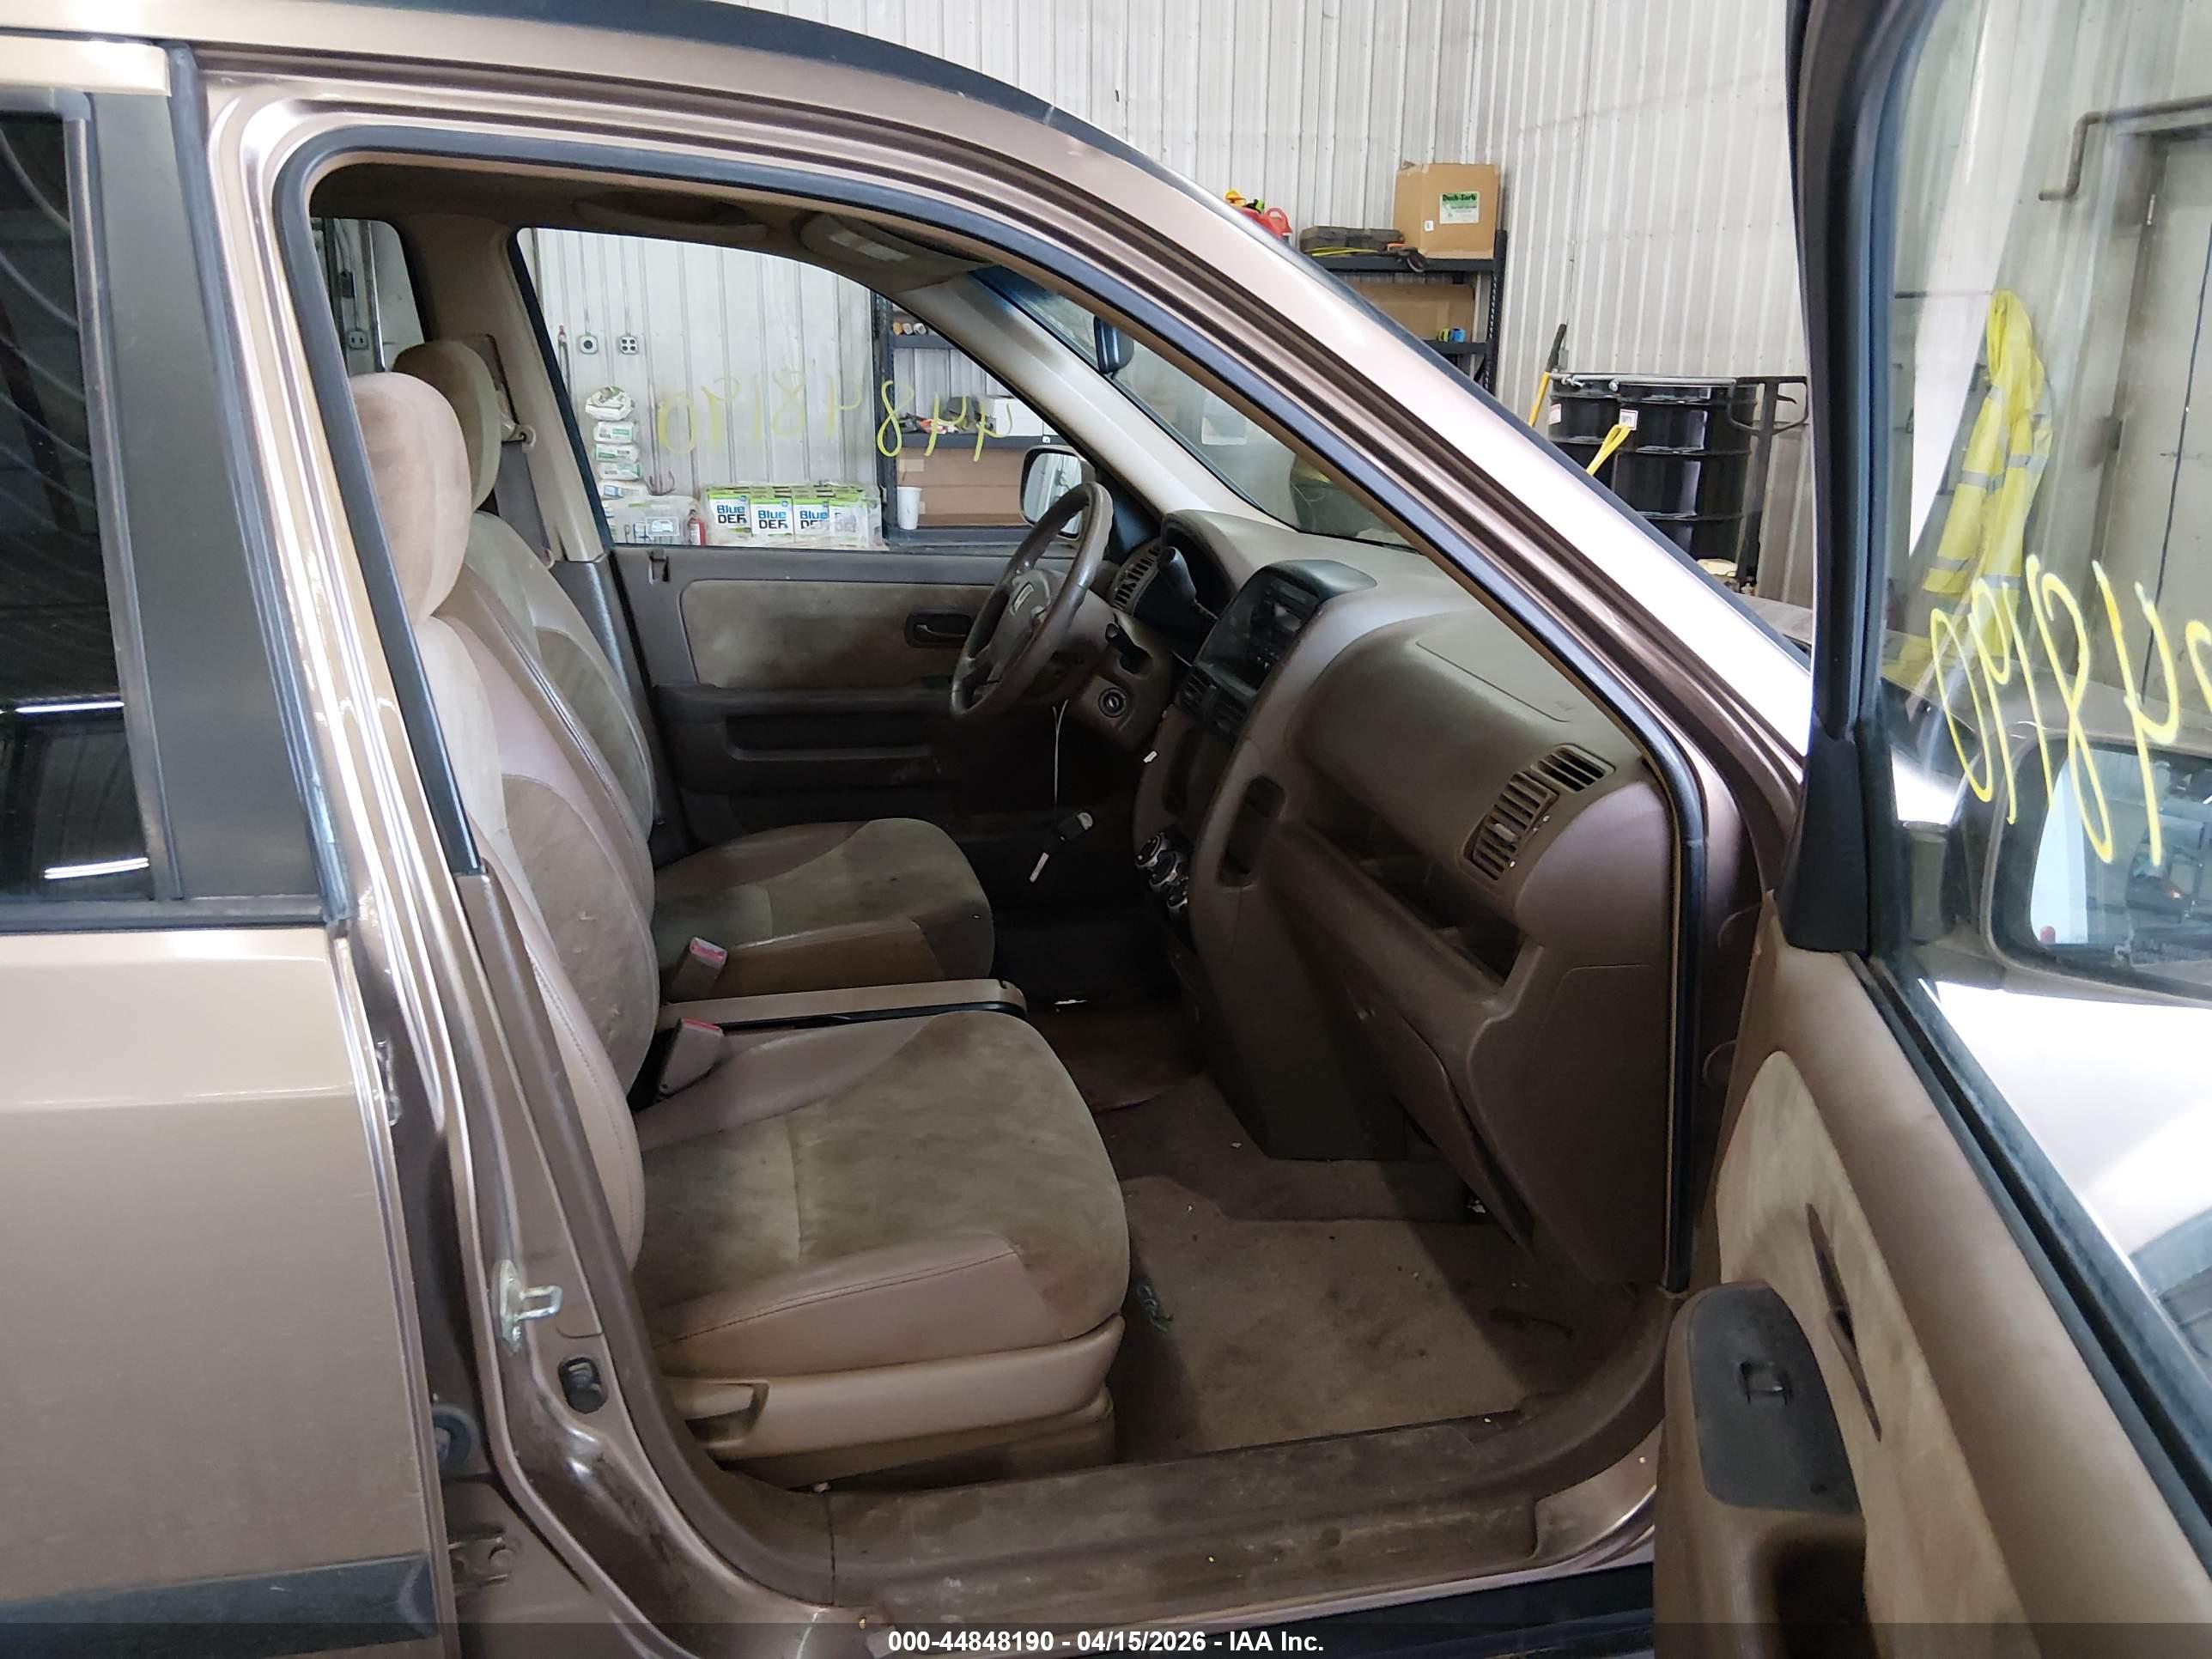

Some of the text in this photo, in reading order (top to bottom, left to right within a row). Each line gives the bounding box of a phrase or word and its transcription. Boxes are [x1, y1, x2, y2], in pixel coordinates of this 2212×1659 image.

[717, 505, 745, 514] Blue
[758, 510, 787, 520] Blue
[799, 510, 829, 520] Blue
